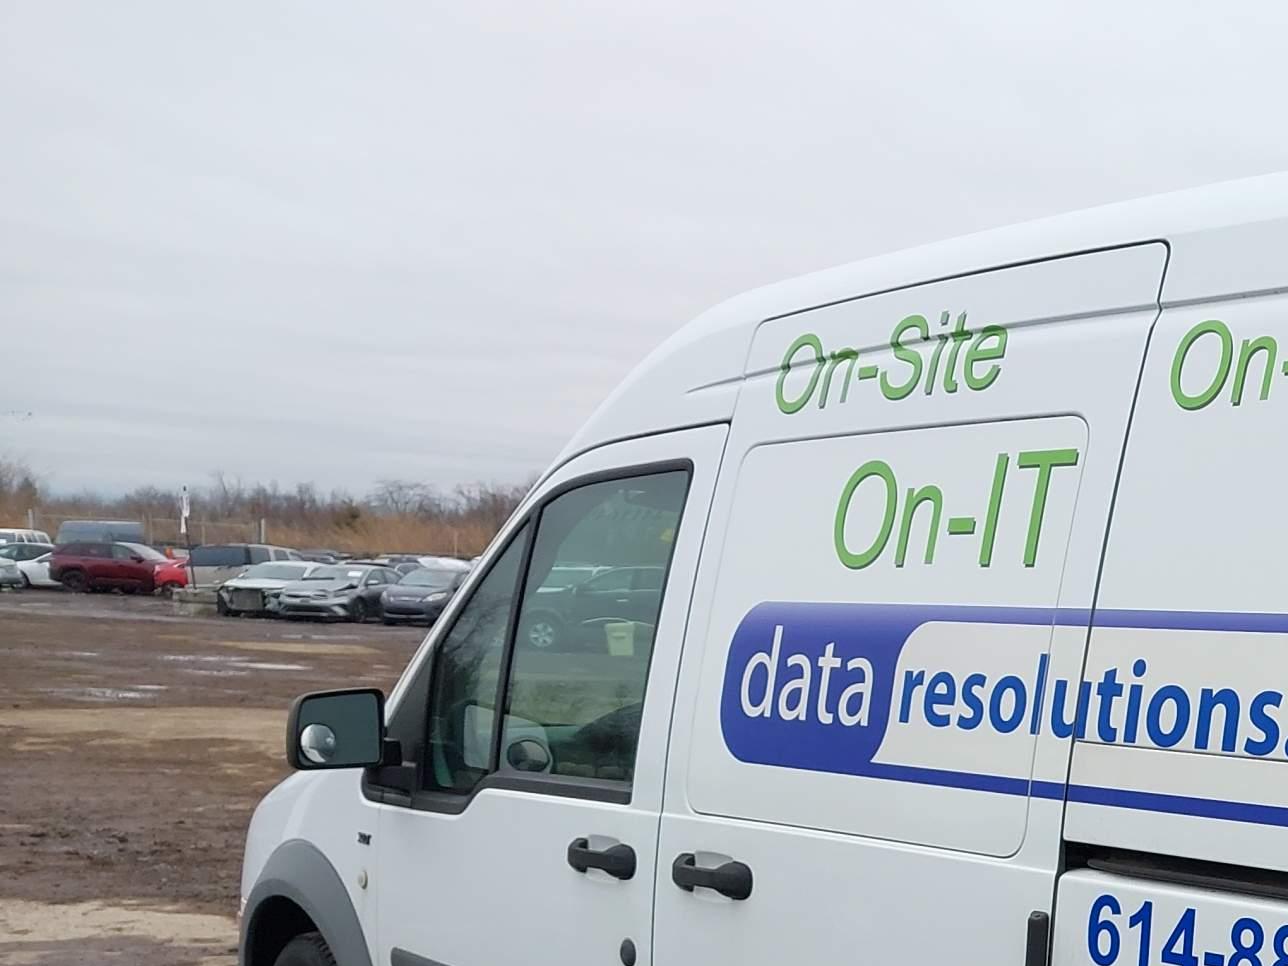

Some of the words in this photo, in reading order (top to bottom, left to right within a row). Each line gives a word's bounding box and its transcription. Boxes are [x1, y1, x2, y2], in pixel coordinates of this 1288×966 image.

[775, 310, 1010, 415] On-Site
[833, 448, 1080, 569] On-IT
[739, 625, 874, 727] data
